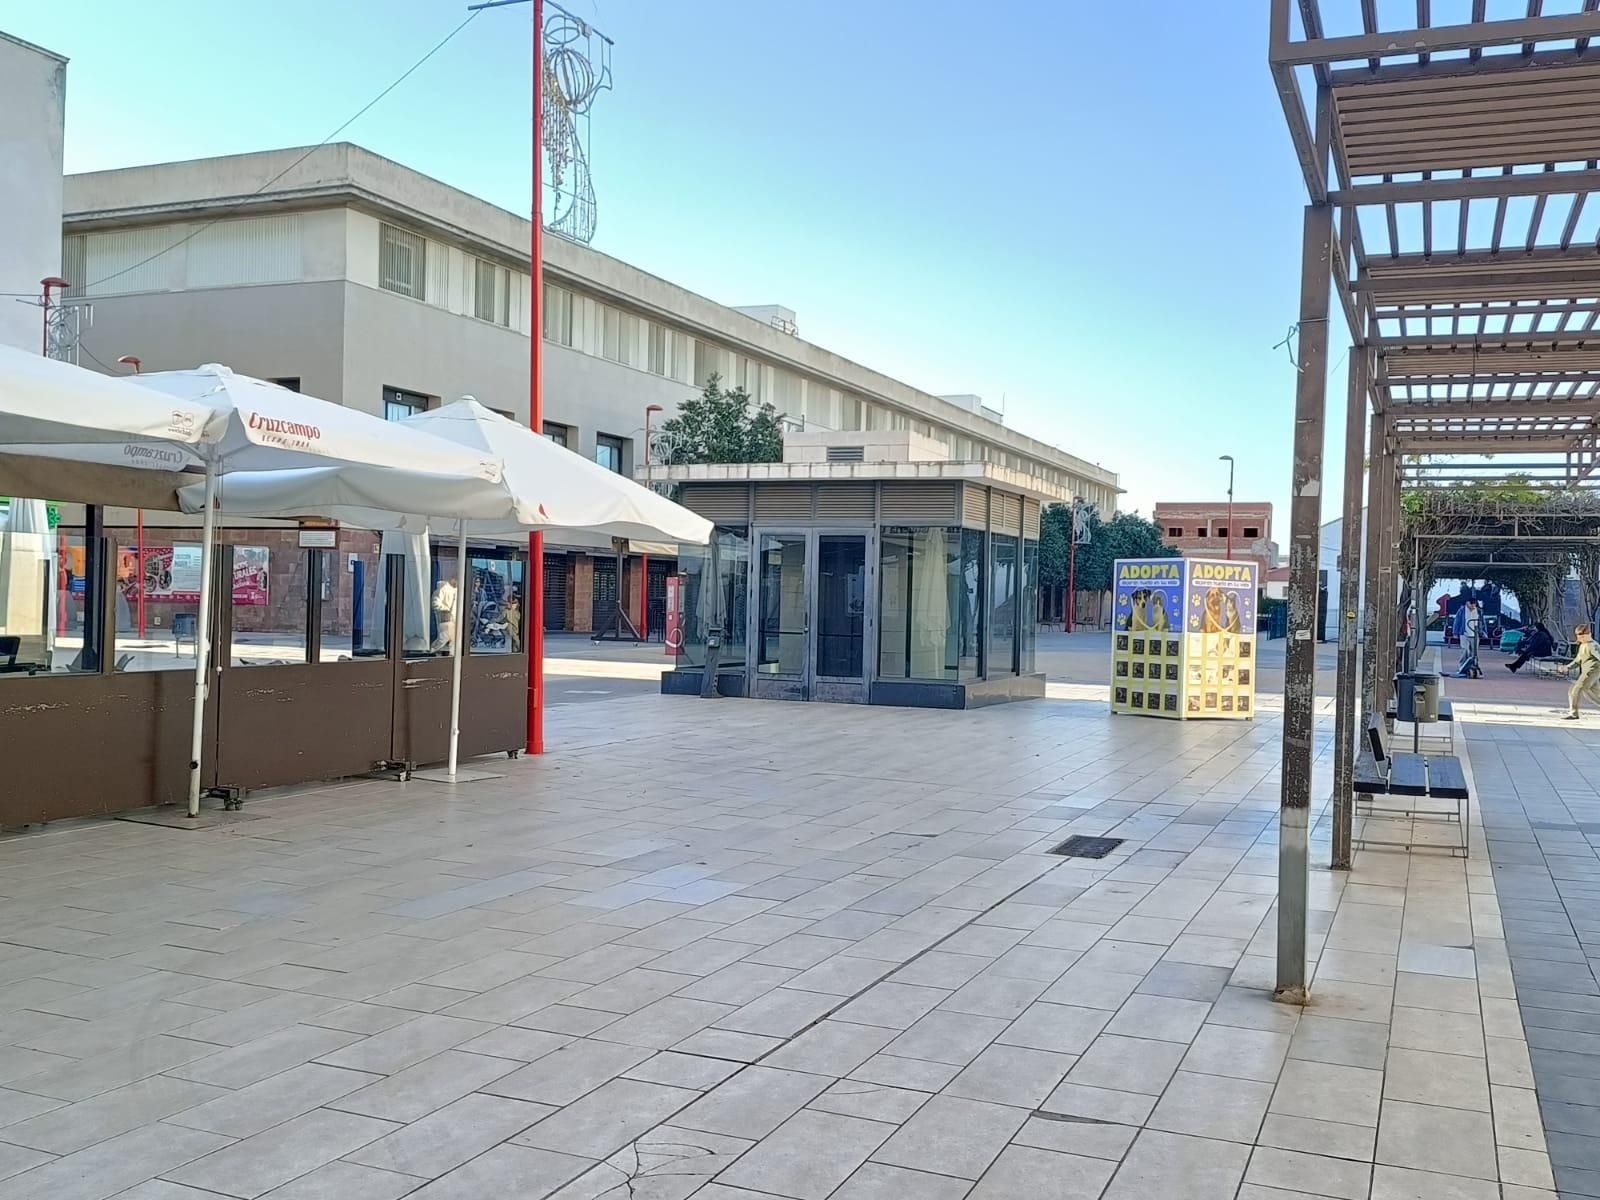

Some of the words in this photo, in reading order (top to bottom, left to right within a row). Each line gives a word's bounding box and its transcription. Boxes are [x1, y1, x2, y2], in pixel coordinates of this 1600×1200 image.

[249, 412, 321, 440] Cruzcampo
[1120, 565, 1180, 579] ADOPTA
[1192, 564, 1251, 580] ADOPTA
